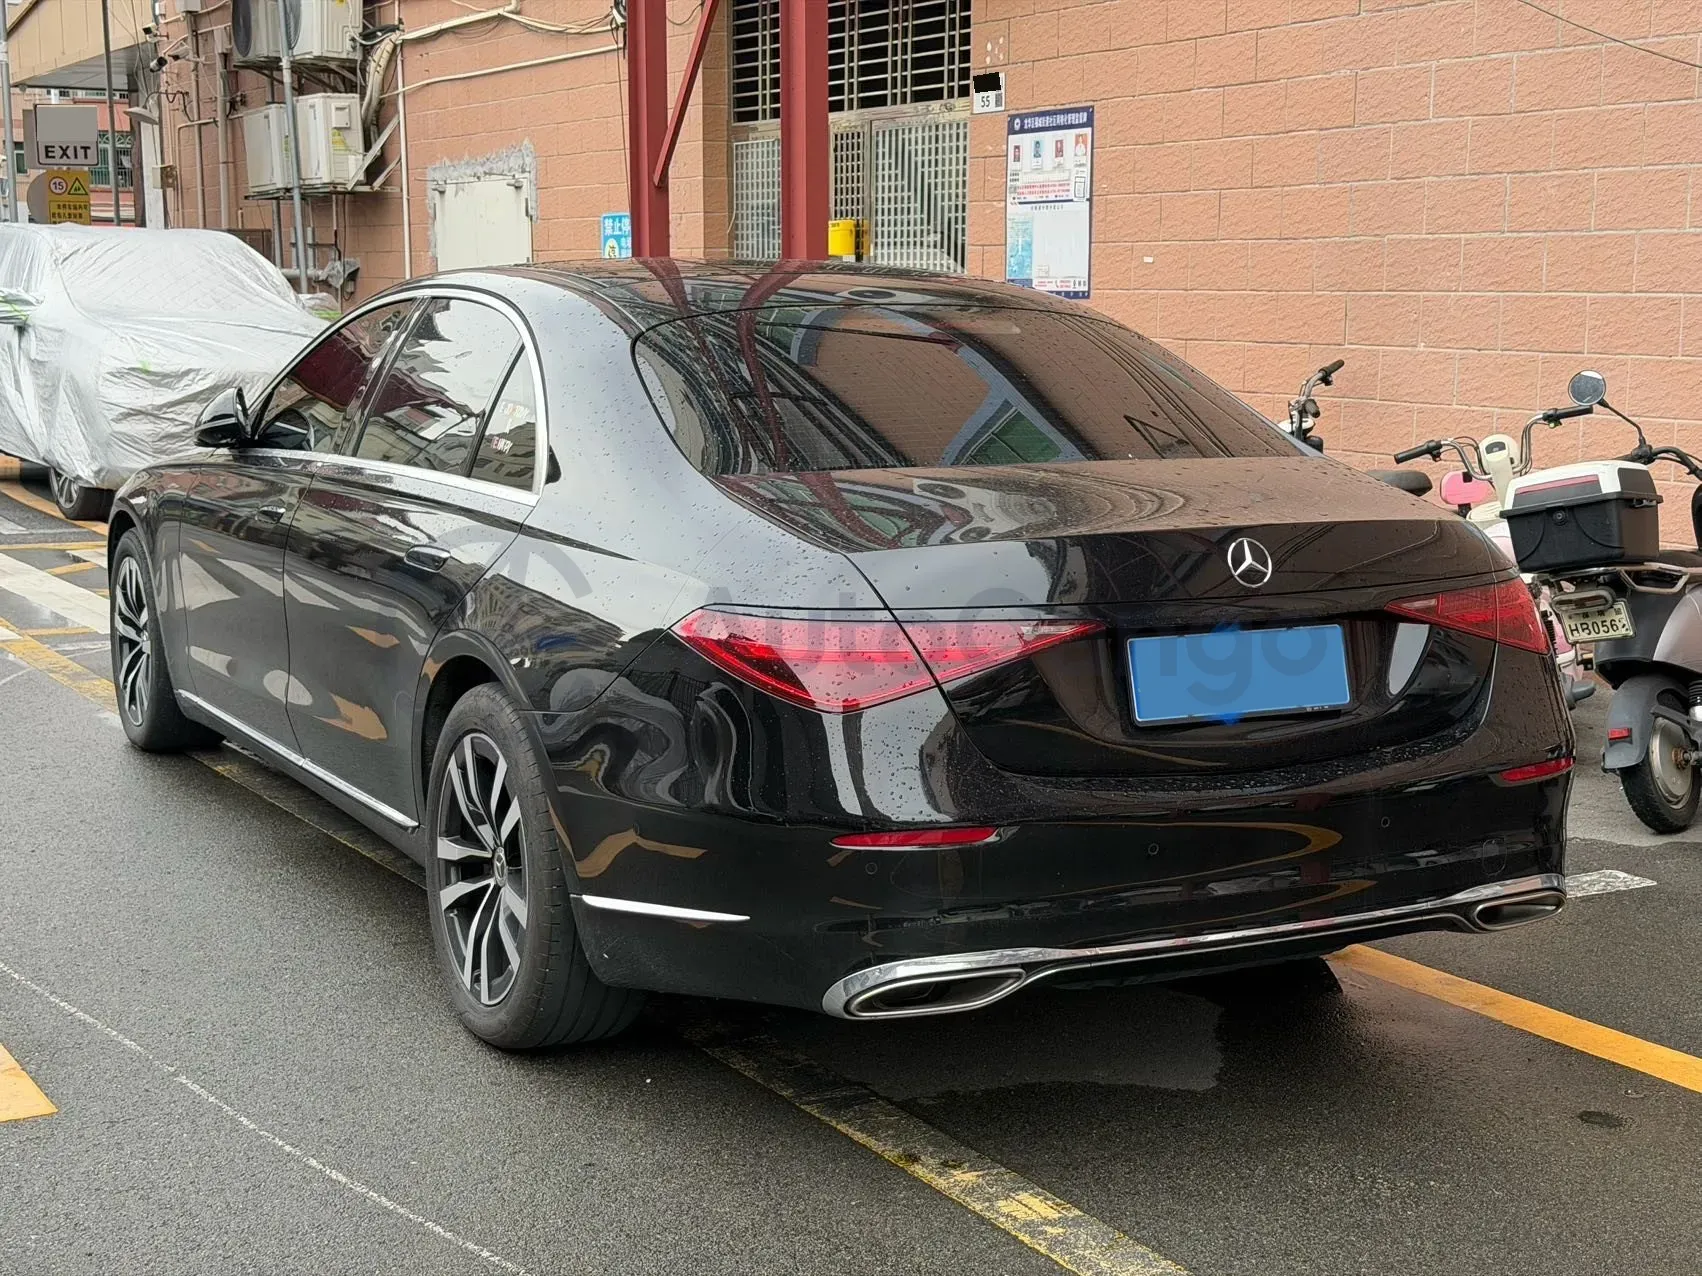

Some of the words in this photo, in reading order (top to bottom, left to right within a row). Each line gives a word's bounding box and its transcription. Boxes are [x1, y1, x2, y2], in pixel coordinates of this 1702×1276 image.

[981, 95, 991, 108] 55
[44, 145, 91, 160] EXIT
[52, 181, 64, 190] 15
